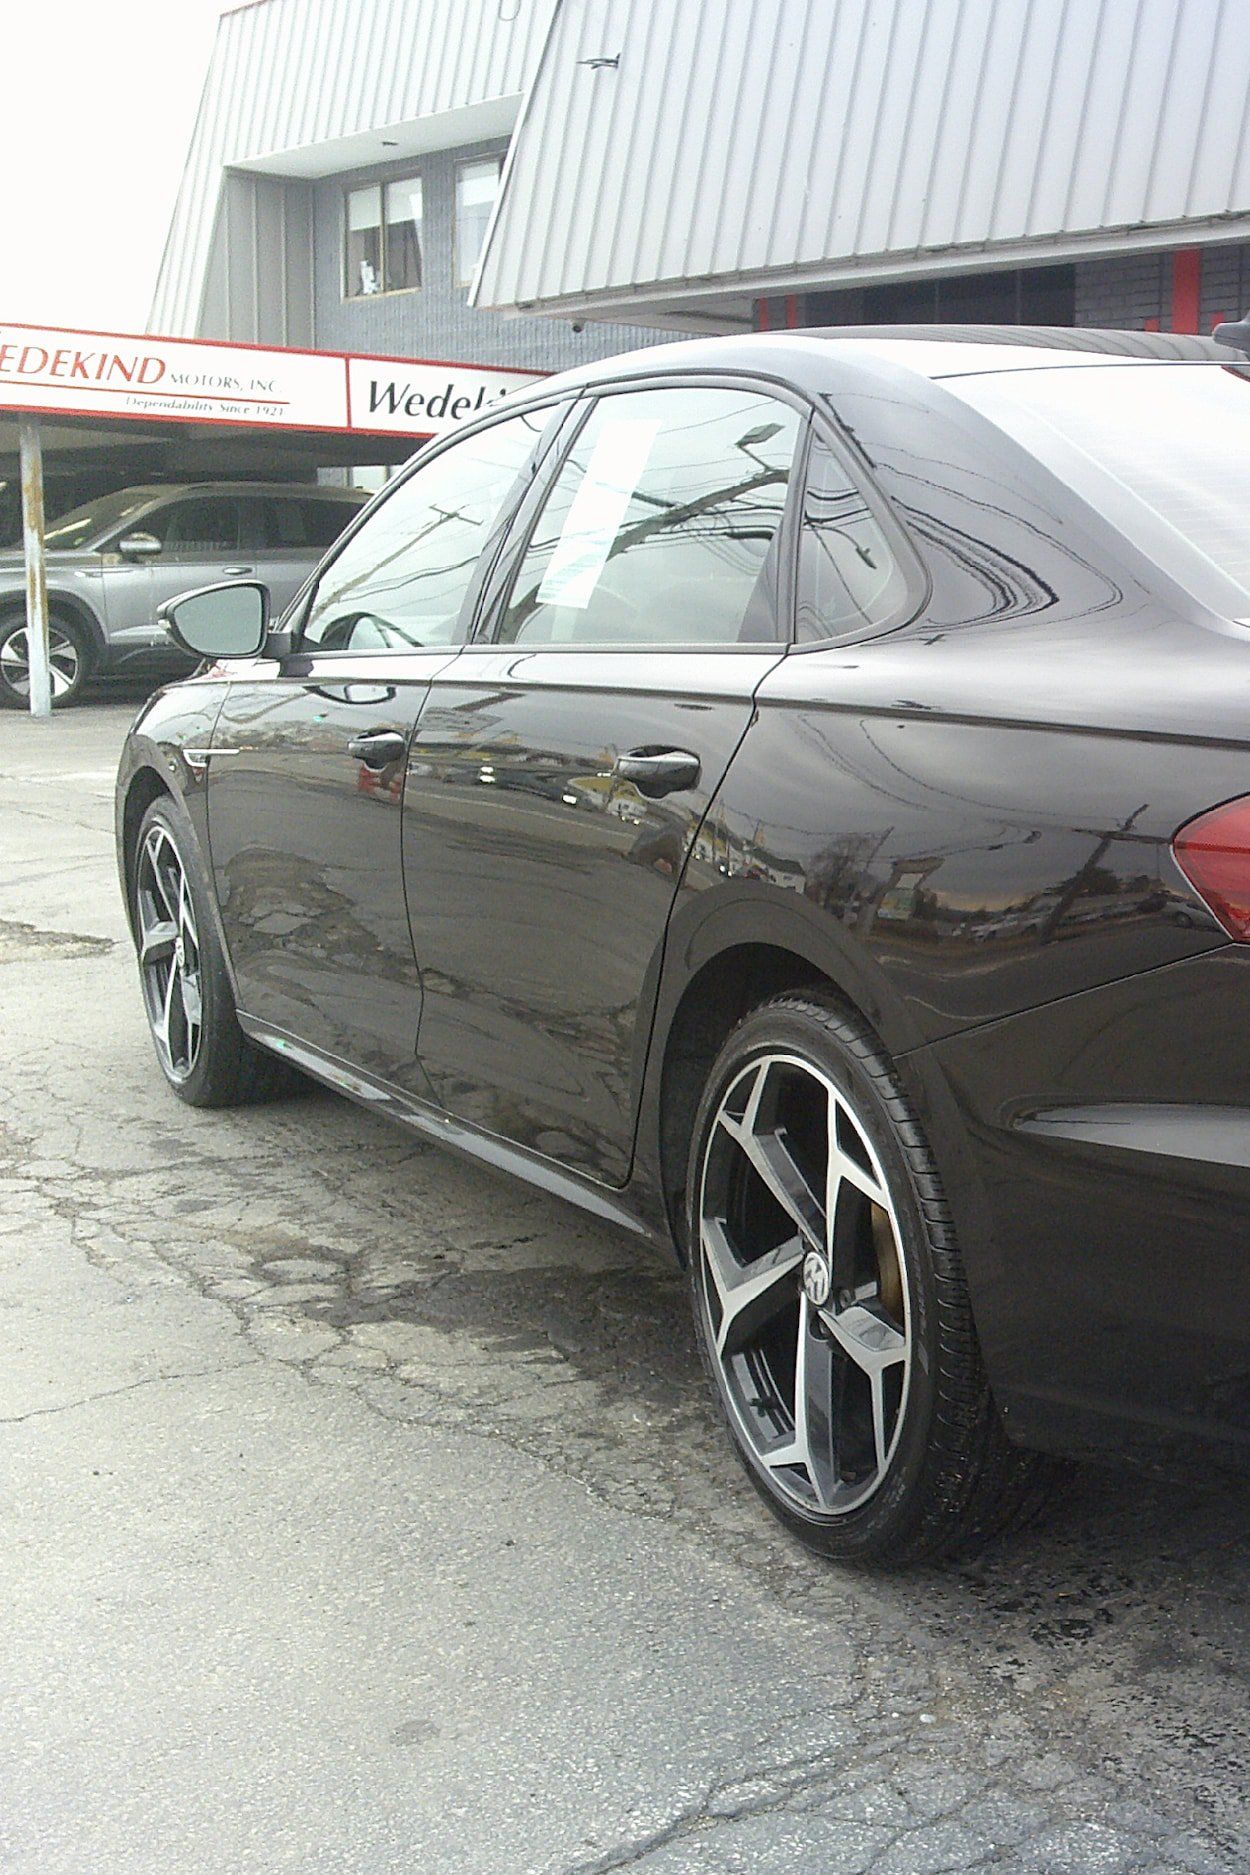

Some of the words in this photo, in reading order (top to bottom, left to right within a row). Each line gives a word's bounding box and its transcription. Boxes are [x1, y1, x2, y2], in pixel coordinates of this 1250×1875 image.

[0, 344, 166, 384] EDEKIND
[171, 373, 244, 392] MOTORS,
[126, 396, 213, 412] Dependability
[220, 403, 250, 415] Since
[256, 406, 284, 416] 1921
[370, 380, 506, 420] Wede
